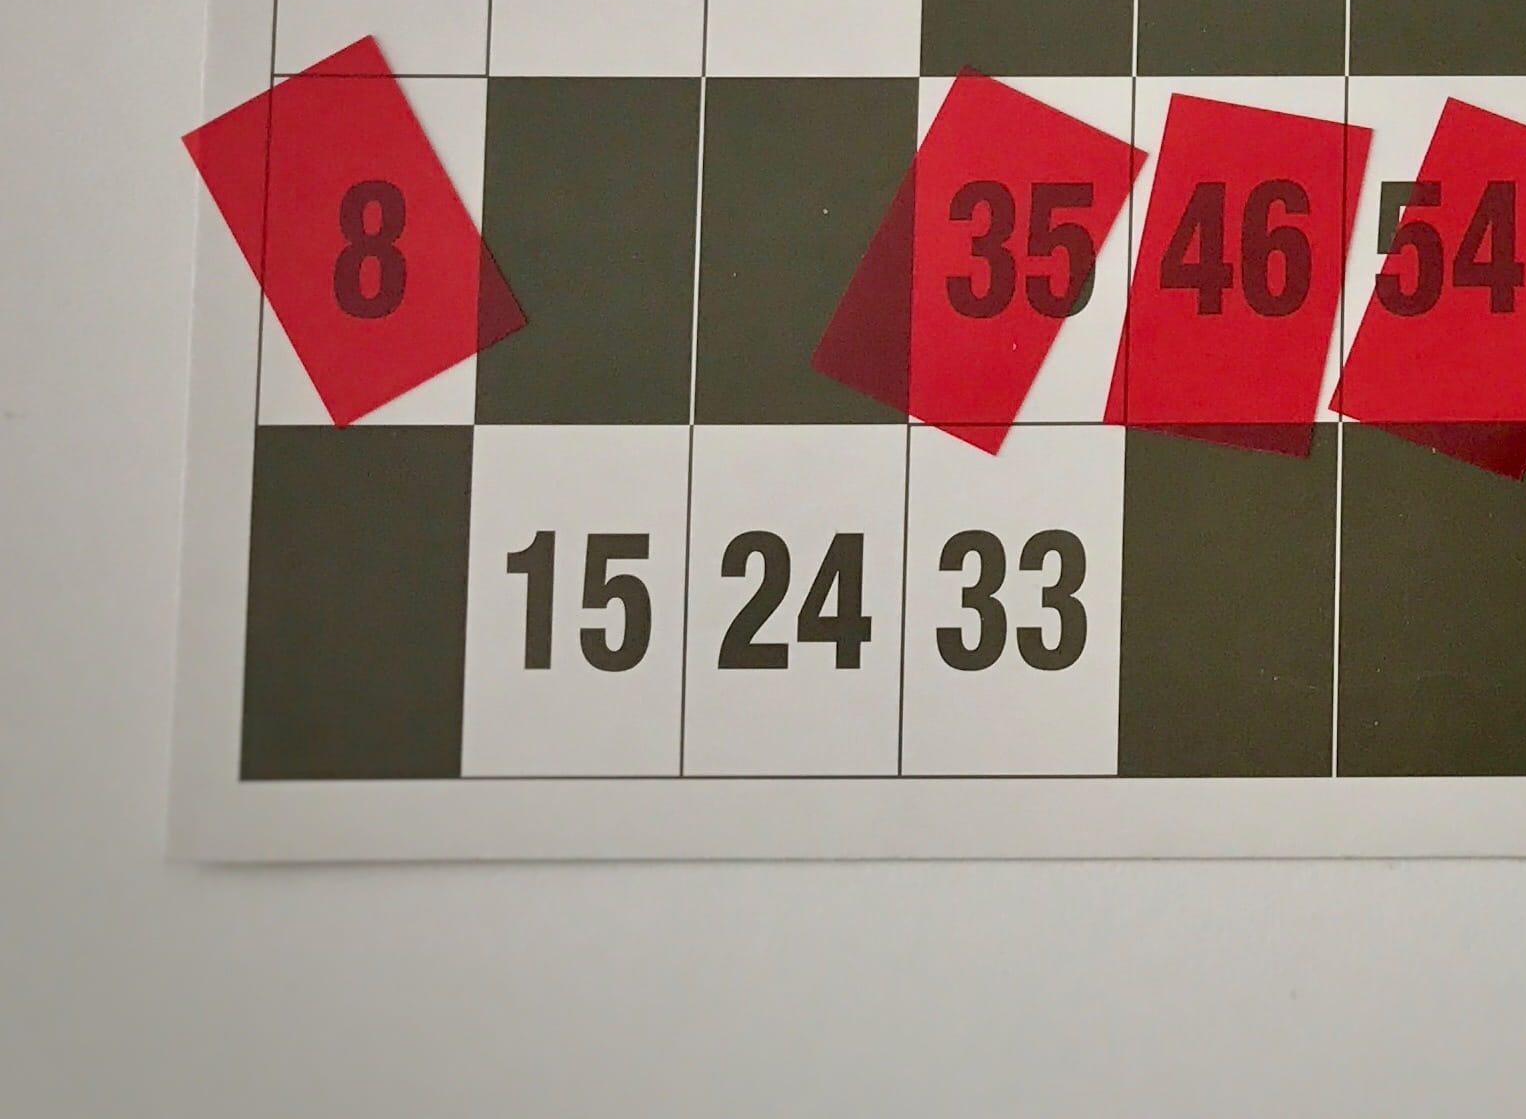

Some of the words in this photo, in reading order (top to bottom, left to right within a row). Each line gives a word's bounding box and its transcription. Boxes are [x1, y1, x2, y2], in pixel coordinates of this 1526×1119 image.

[333, 180, 406, 319] 8
[946, 181, 1097, 321] 35
[1160, 179, 1312, 317] 46
[1373, 178, 1525, 317] 54
[507, 531, 651, 672] 15
[718, 531, 872, 669] 24
[936, 530, 1087, 671] 33
